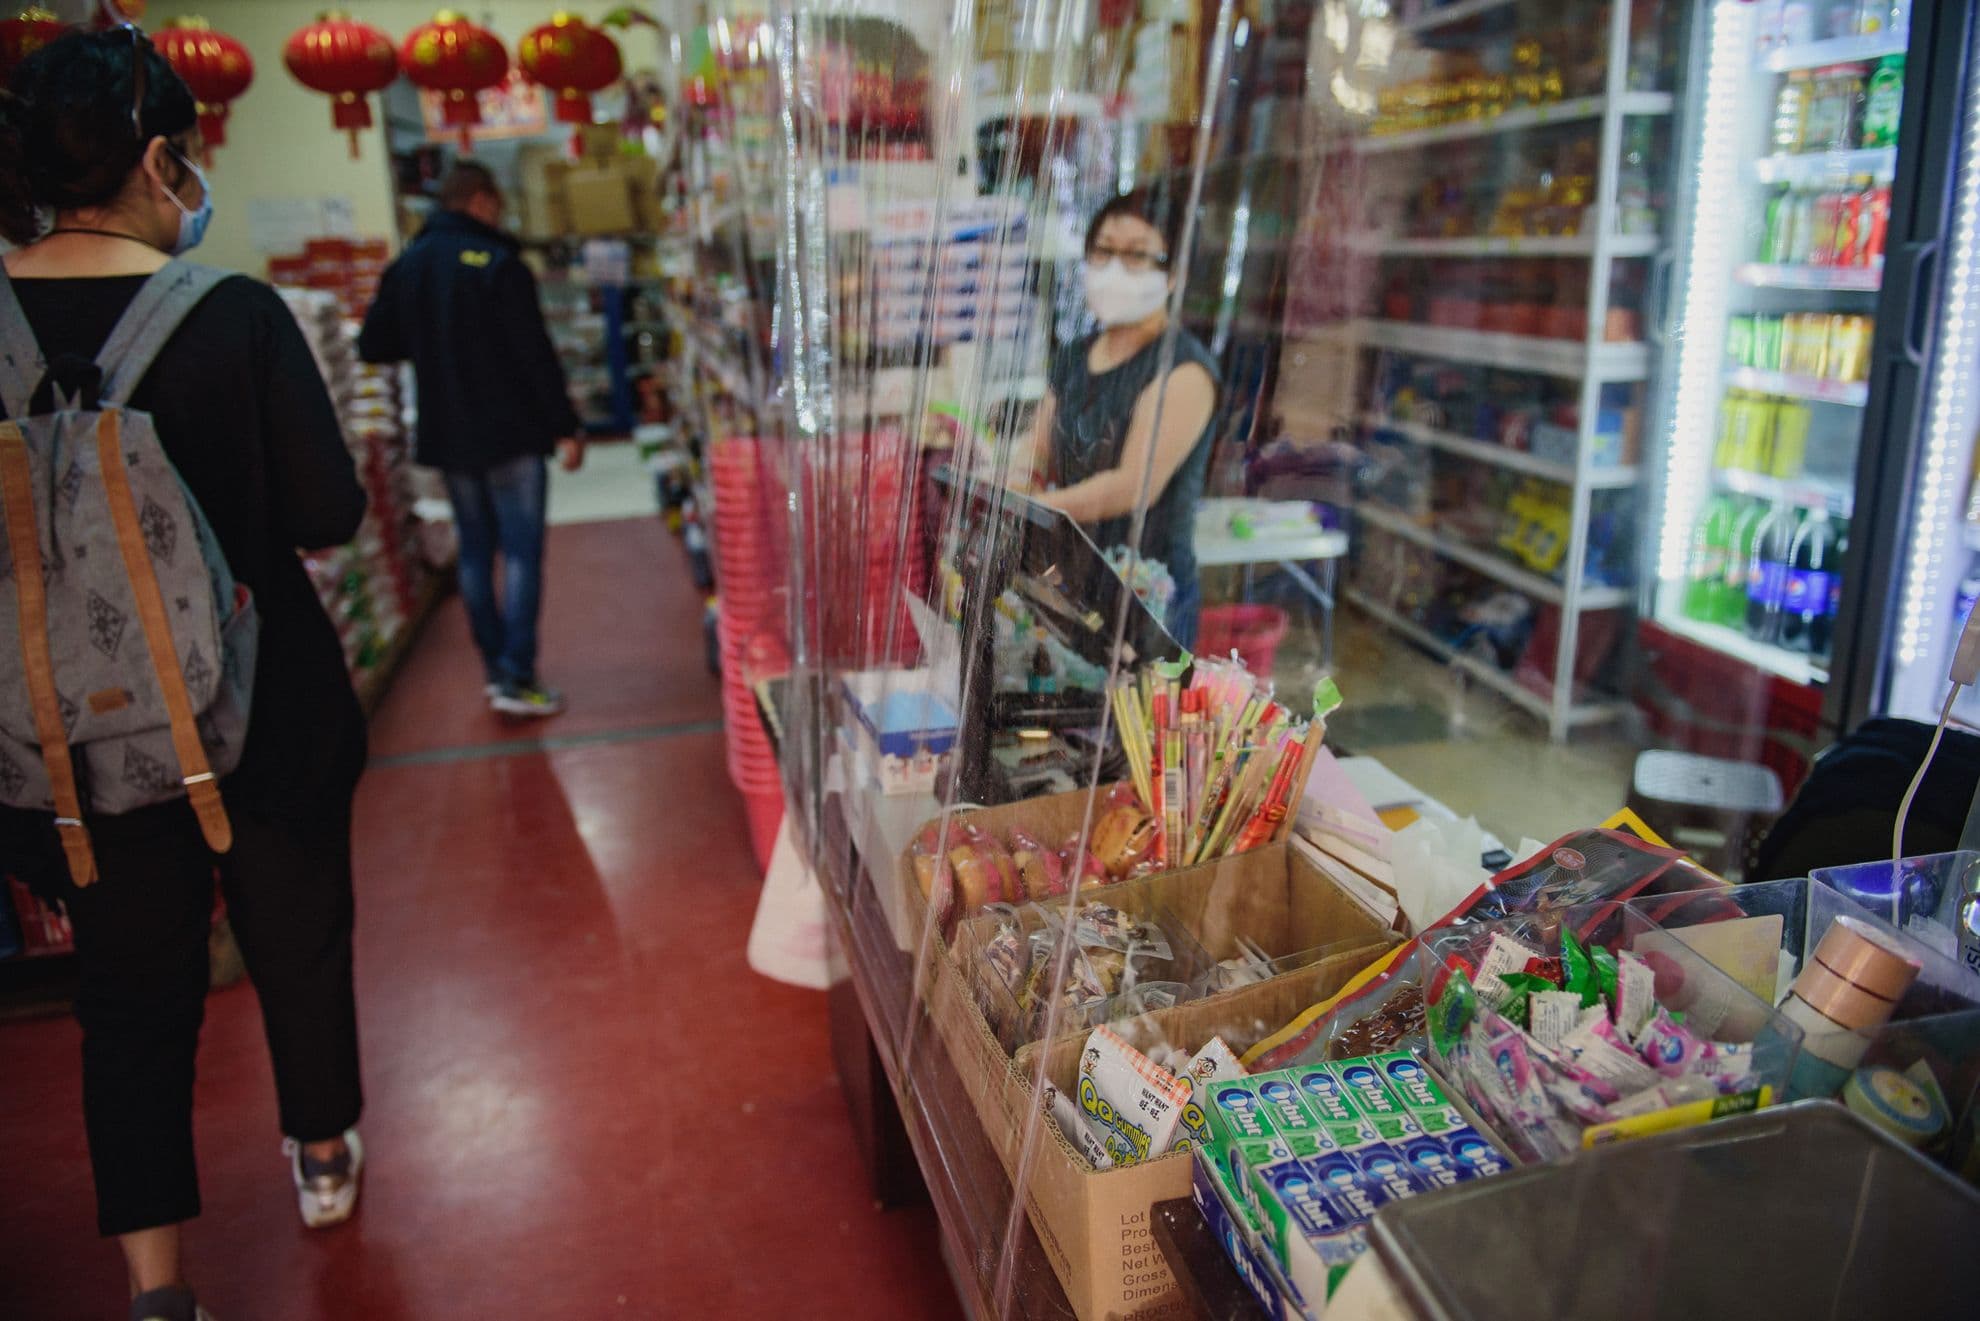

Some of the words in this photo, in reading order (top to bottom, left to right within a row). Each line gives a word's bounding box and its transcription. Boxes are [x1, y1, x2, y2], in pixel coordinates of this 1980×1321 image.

[1142, 1088, 1156, 1103] WANT
[1154, 1098, 1169, 1112] WANT
[1303, 1074, 1349, 1120] Orbit
[1346, 1068, 1392, 1112] Orbit
[1390, 1061, 1436, 1105] Orbit
[1080, 1078, 1114, 1123] QQ
[1115, 1112, 1152, 1160] Gummies
[1220, 1090, 1263, 1137] Orbit
[1263, 1083, 1308, 1128] Orbit
[1121, 1211, 1145, 1225] Lot
[1280, 1176, 1333, 1229] Orbit
[1122, 1239, 1156, 1256] Best
[1122, 1256, 1148, 1271] Net
[1152, 1252, 1167, 1265] W
[1122, 1268, 1168, 1286] Gross
[1123, 1281, 1179, 1301] Dimens
